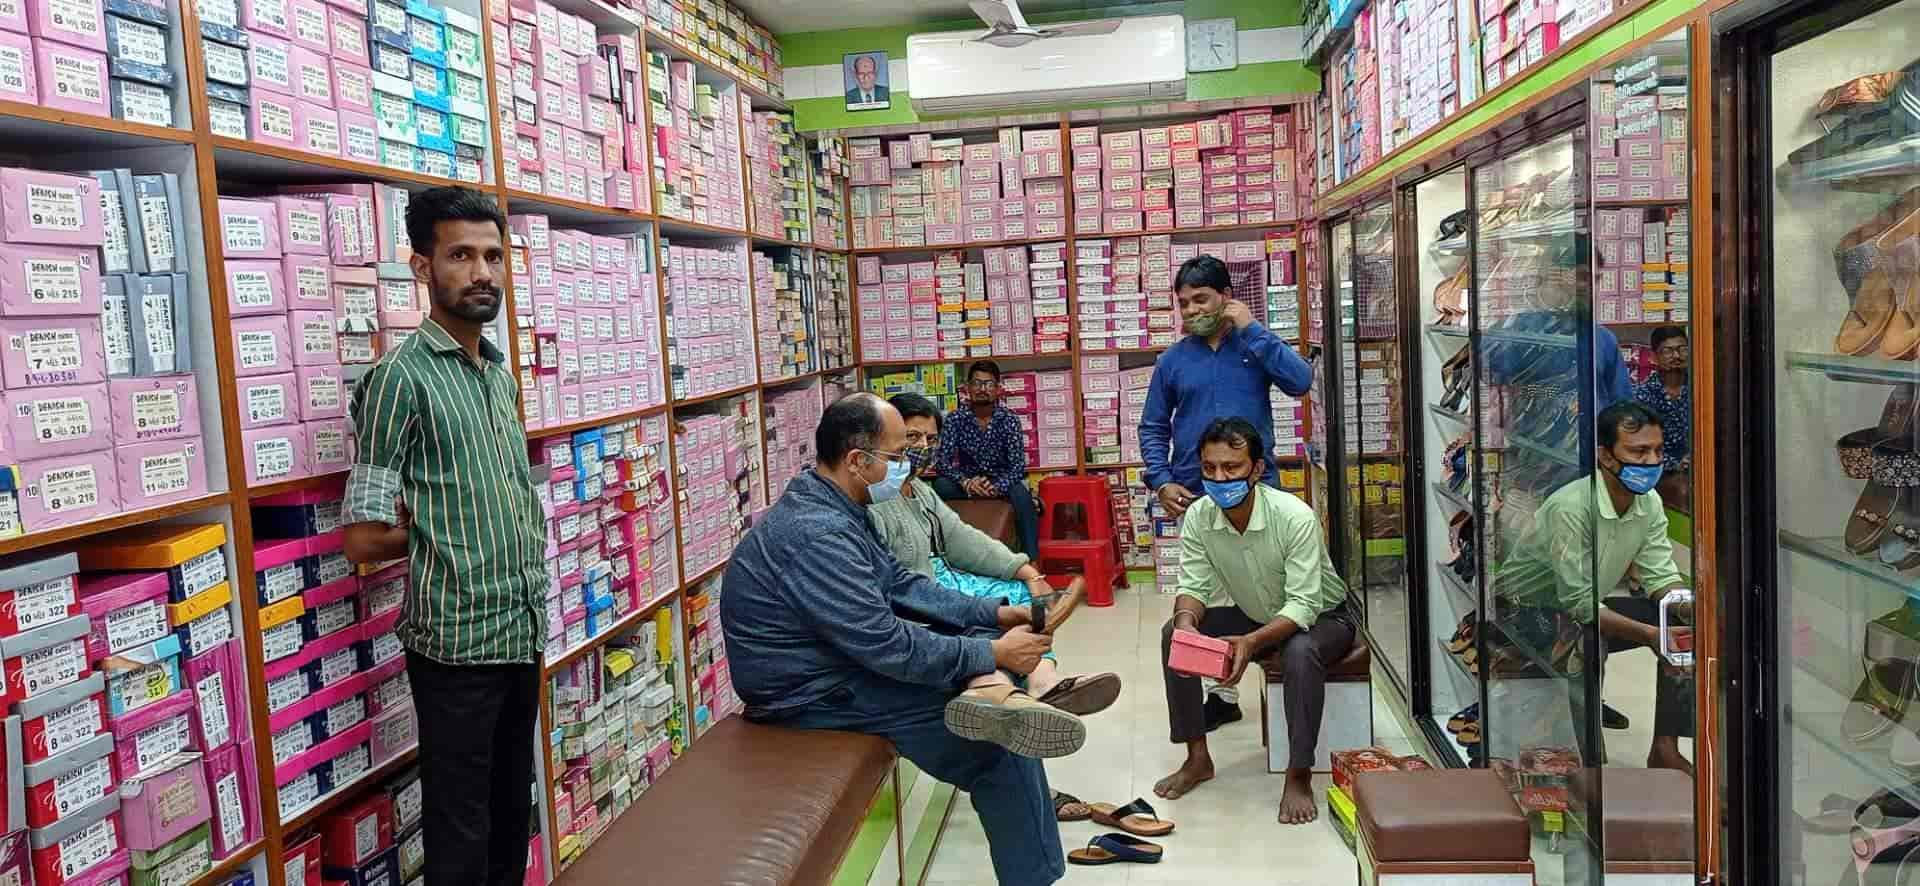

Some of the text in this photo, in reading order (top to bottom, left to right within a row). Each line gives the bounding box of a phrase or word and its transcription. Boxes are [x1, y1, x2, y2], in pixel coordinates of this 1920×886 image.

[54, 14, 63, 24] 8
[58, 82, 68, 92] 9
[32, 214, 78, 226] 9 215
[292, 231, 300, 241] 9
[34, 288, 78, 300] 6 215
[32, 358, 44, 369] 7
[18, 406, 30, 416] 10
[138, 416, 177, 428] 8 215
[42, 428, 53, 440] 8
[170, 480, 186, 489] 215
[26, 486, 37, 497] 10
[51, 498, 62, 510] 8
[186, 584, 195, 594] 9
[20, 614, 32, 625] 10
[112, 628, 156, 649] 10 323
[194, 642, 202, 652] 9
[30, 666, 76, 692] 9 322
[125, 696, 133, 706] 7
[51, 738, 58, 750] 8
[76, 724, 92, 738] 322
[140, 754, 148, 766] 9
[60, 800, 69, 812] 9
[86, 784, 102, 798] 322
[66, 846, 108, 876] 8 322
